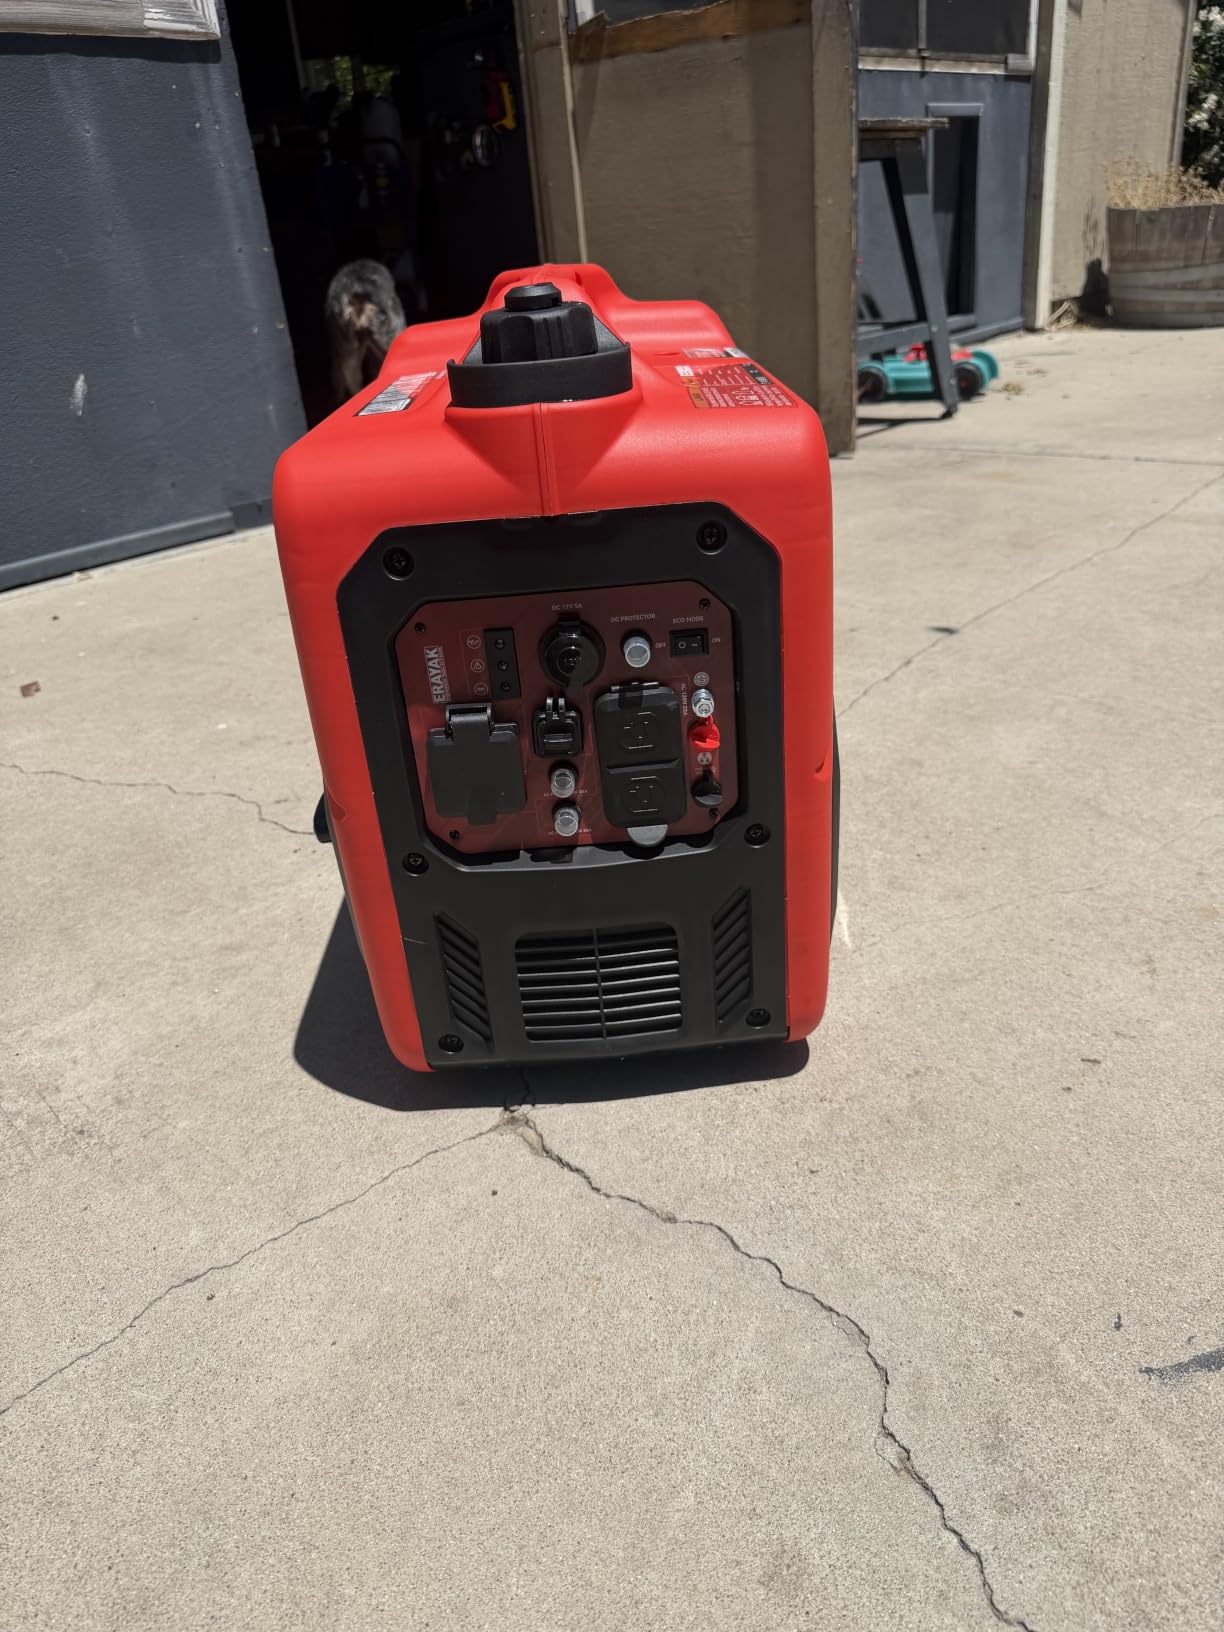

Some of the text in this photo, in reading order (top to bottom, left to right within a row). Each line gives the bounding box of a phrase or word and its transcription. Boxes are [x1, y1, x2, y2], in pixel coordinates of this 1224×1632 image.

[620, 613, 656, 622] PROTECTOR
[686, 615, 704, 623] MODE
[711, 636, 721, 644] ON
[425, 648, 446, 703] ERAYAK
